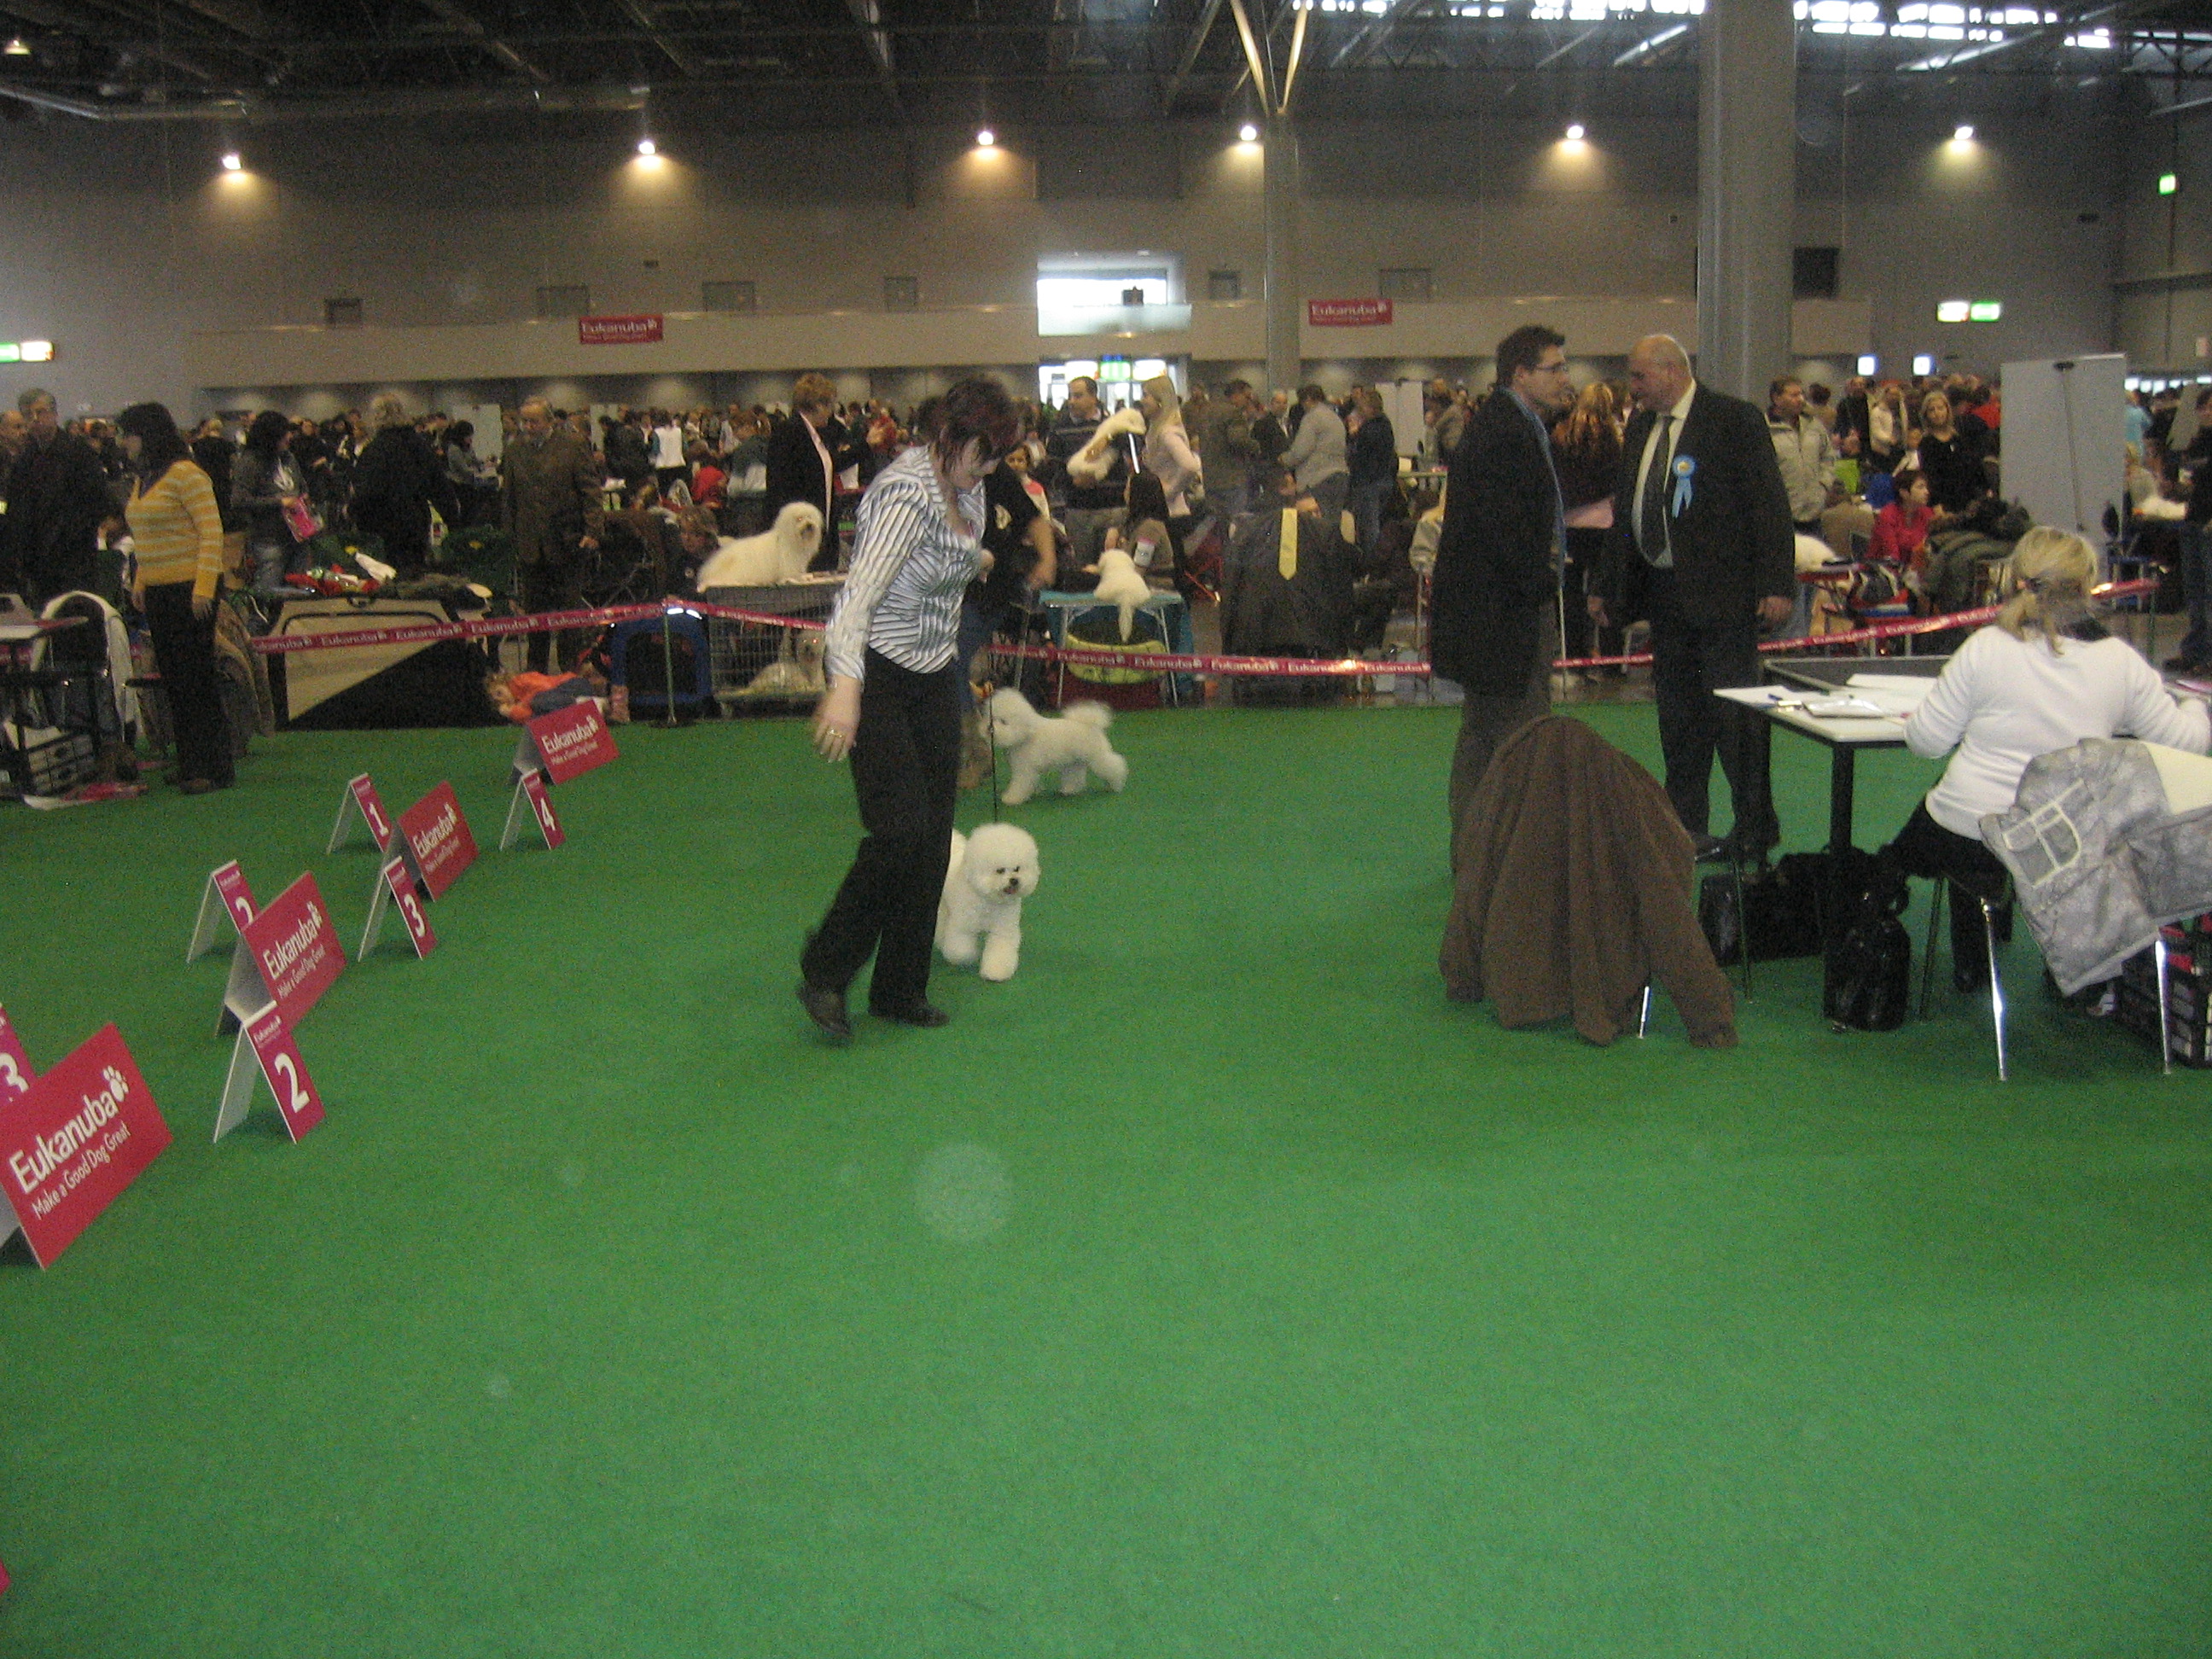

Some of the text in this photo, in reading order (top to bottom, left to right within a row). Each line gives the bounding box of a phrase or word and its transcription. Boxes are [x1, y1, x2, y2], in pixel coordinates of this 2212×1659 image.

[395, 627, 452, 640] Eukanuba
[471, 620, 529, 633] Eukanuba
[1134, 657, 1192, 669] Eukanuba
[1211, 660, 1270, 672] Eukanuba
[540, 723, 594, 754] Eukanuba
[369, 802, 389, 837] 1
[540, 797, 556, 831] 4
[412, 815, 454, 859] Eukanuba
[404, 894, 426, 938] 3
[263, 917, 319, 981] Eukanuba
[274, 1052, 311, 1114] 2
[9, 1093, 120, 1195] Eukanuba
[32, 1119, 131, 1221] Make a Good Dog Great
